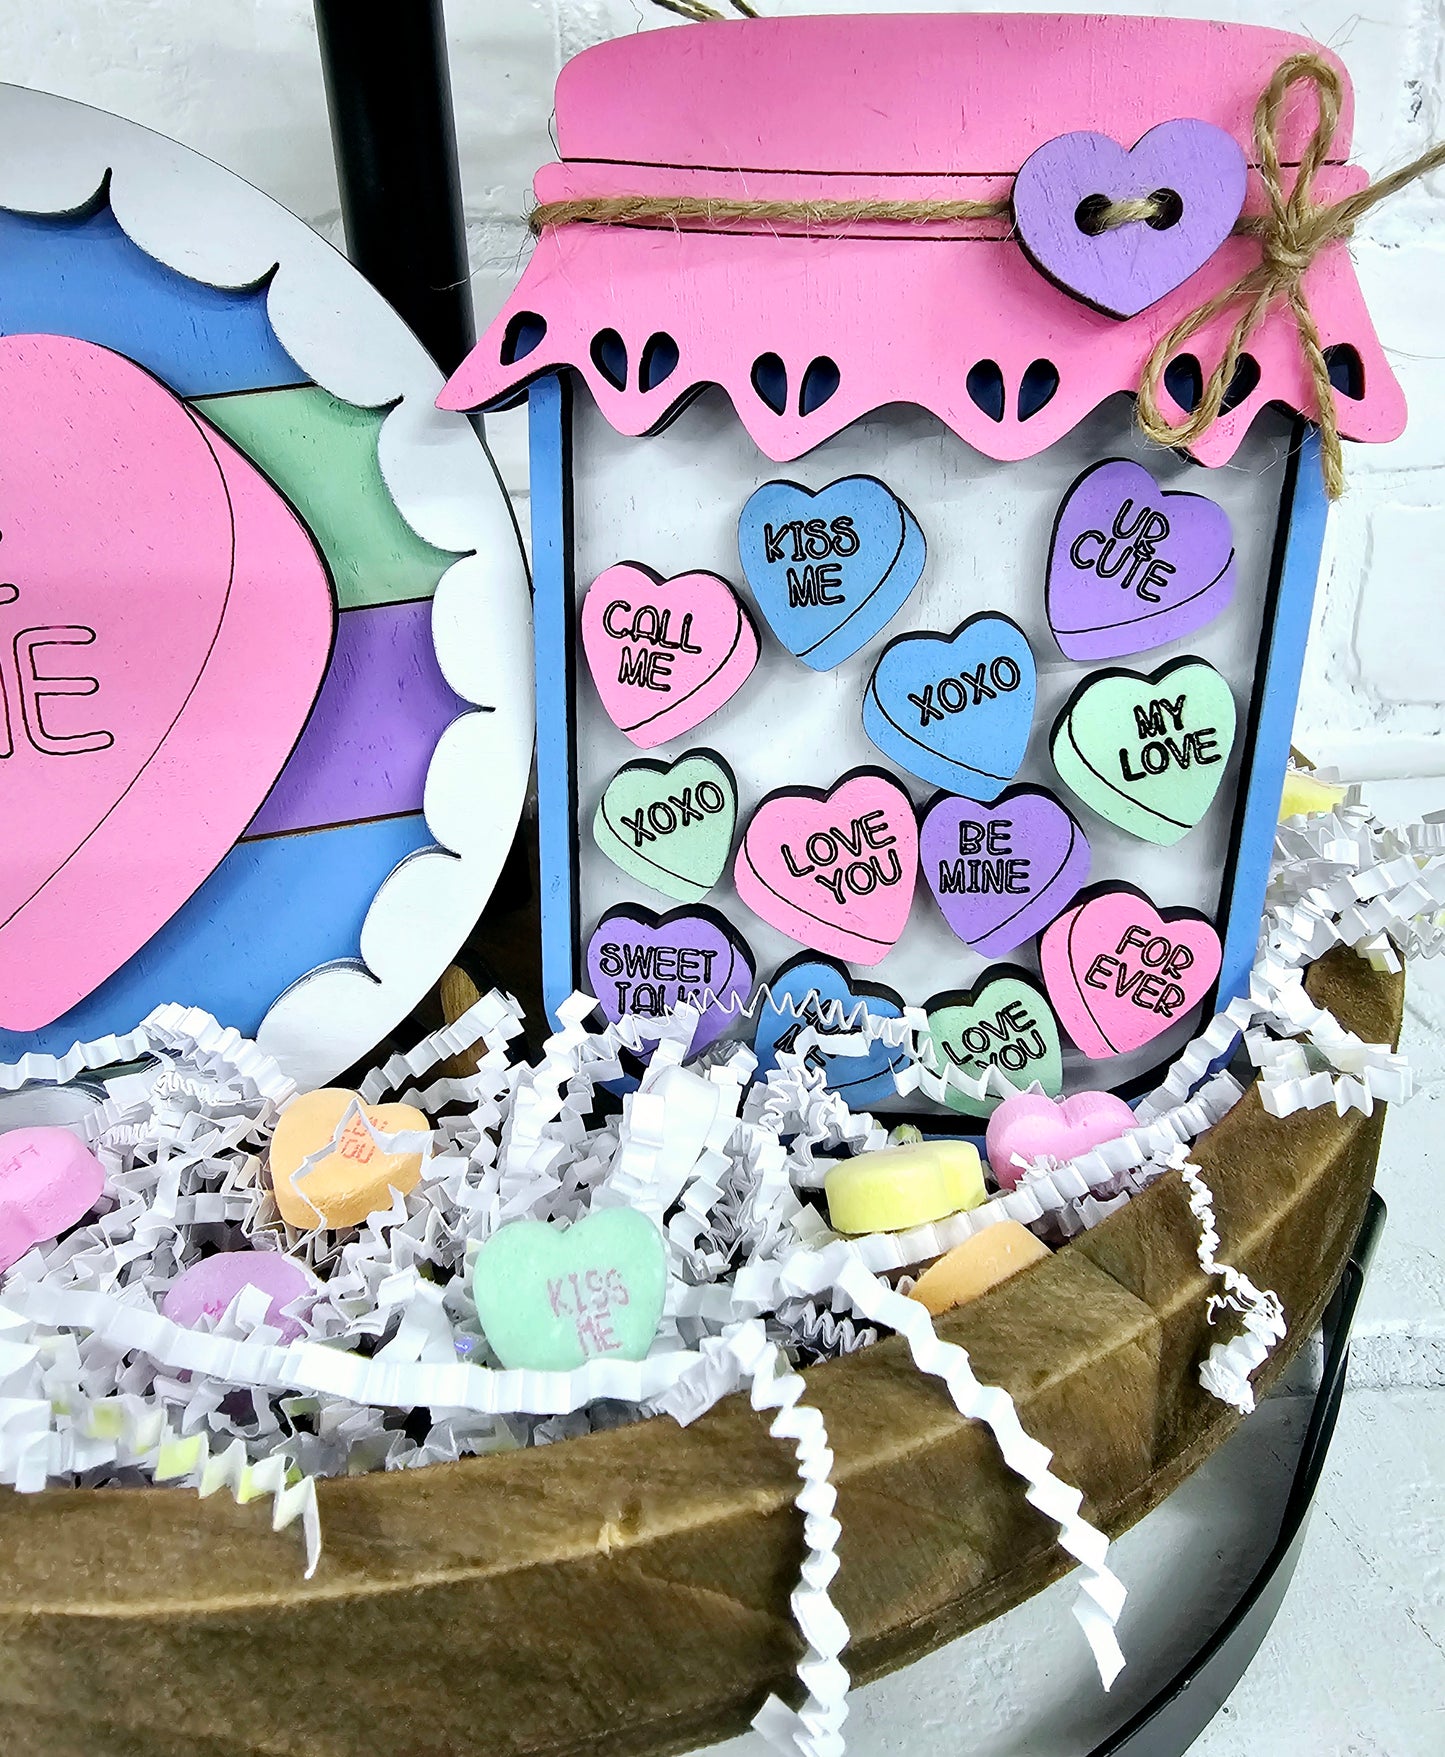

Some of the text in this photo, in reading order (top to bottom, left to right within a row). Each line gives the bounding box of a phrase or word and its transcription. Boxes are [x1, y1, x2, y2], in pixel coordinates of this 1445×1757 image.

[764, 516, 860, 563] KISS
[1112, 498, 1170, 554] UR
[787, 563, 846, 608] ME
[1070, 530, 1176, 602] CUTE
[603, 600, 702, 654] CALL
[618, 646, 675, 692] ME
[908, 656, 1021, 727] XOXO
[1134, 694, 1186, 740] MY
[1119, 728, 1222, 782] LOVE
[621, 781, 725, 847] XOXO
[959, 820, 1013, 856] BE
[780, 810, 896, 876] LOVE
[816, 849, 902, 904] YOU
[939, 859, 1031, 894] MINE
[599, 942, 718, 984] SWEET
[1115, 925, 1194, 980] FOR
[1084, 953, 1186, 1018] EVER
[942, 1000, 1037, 1066] LOVE
[547, 1268, 630, 1318] KISS
[576, 1311, 624, 1357] ME
